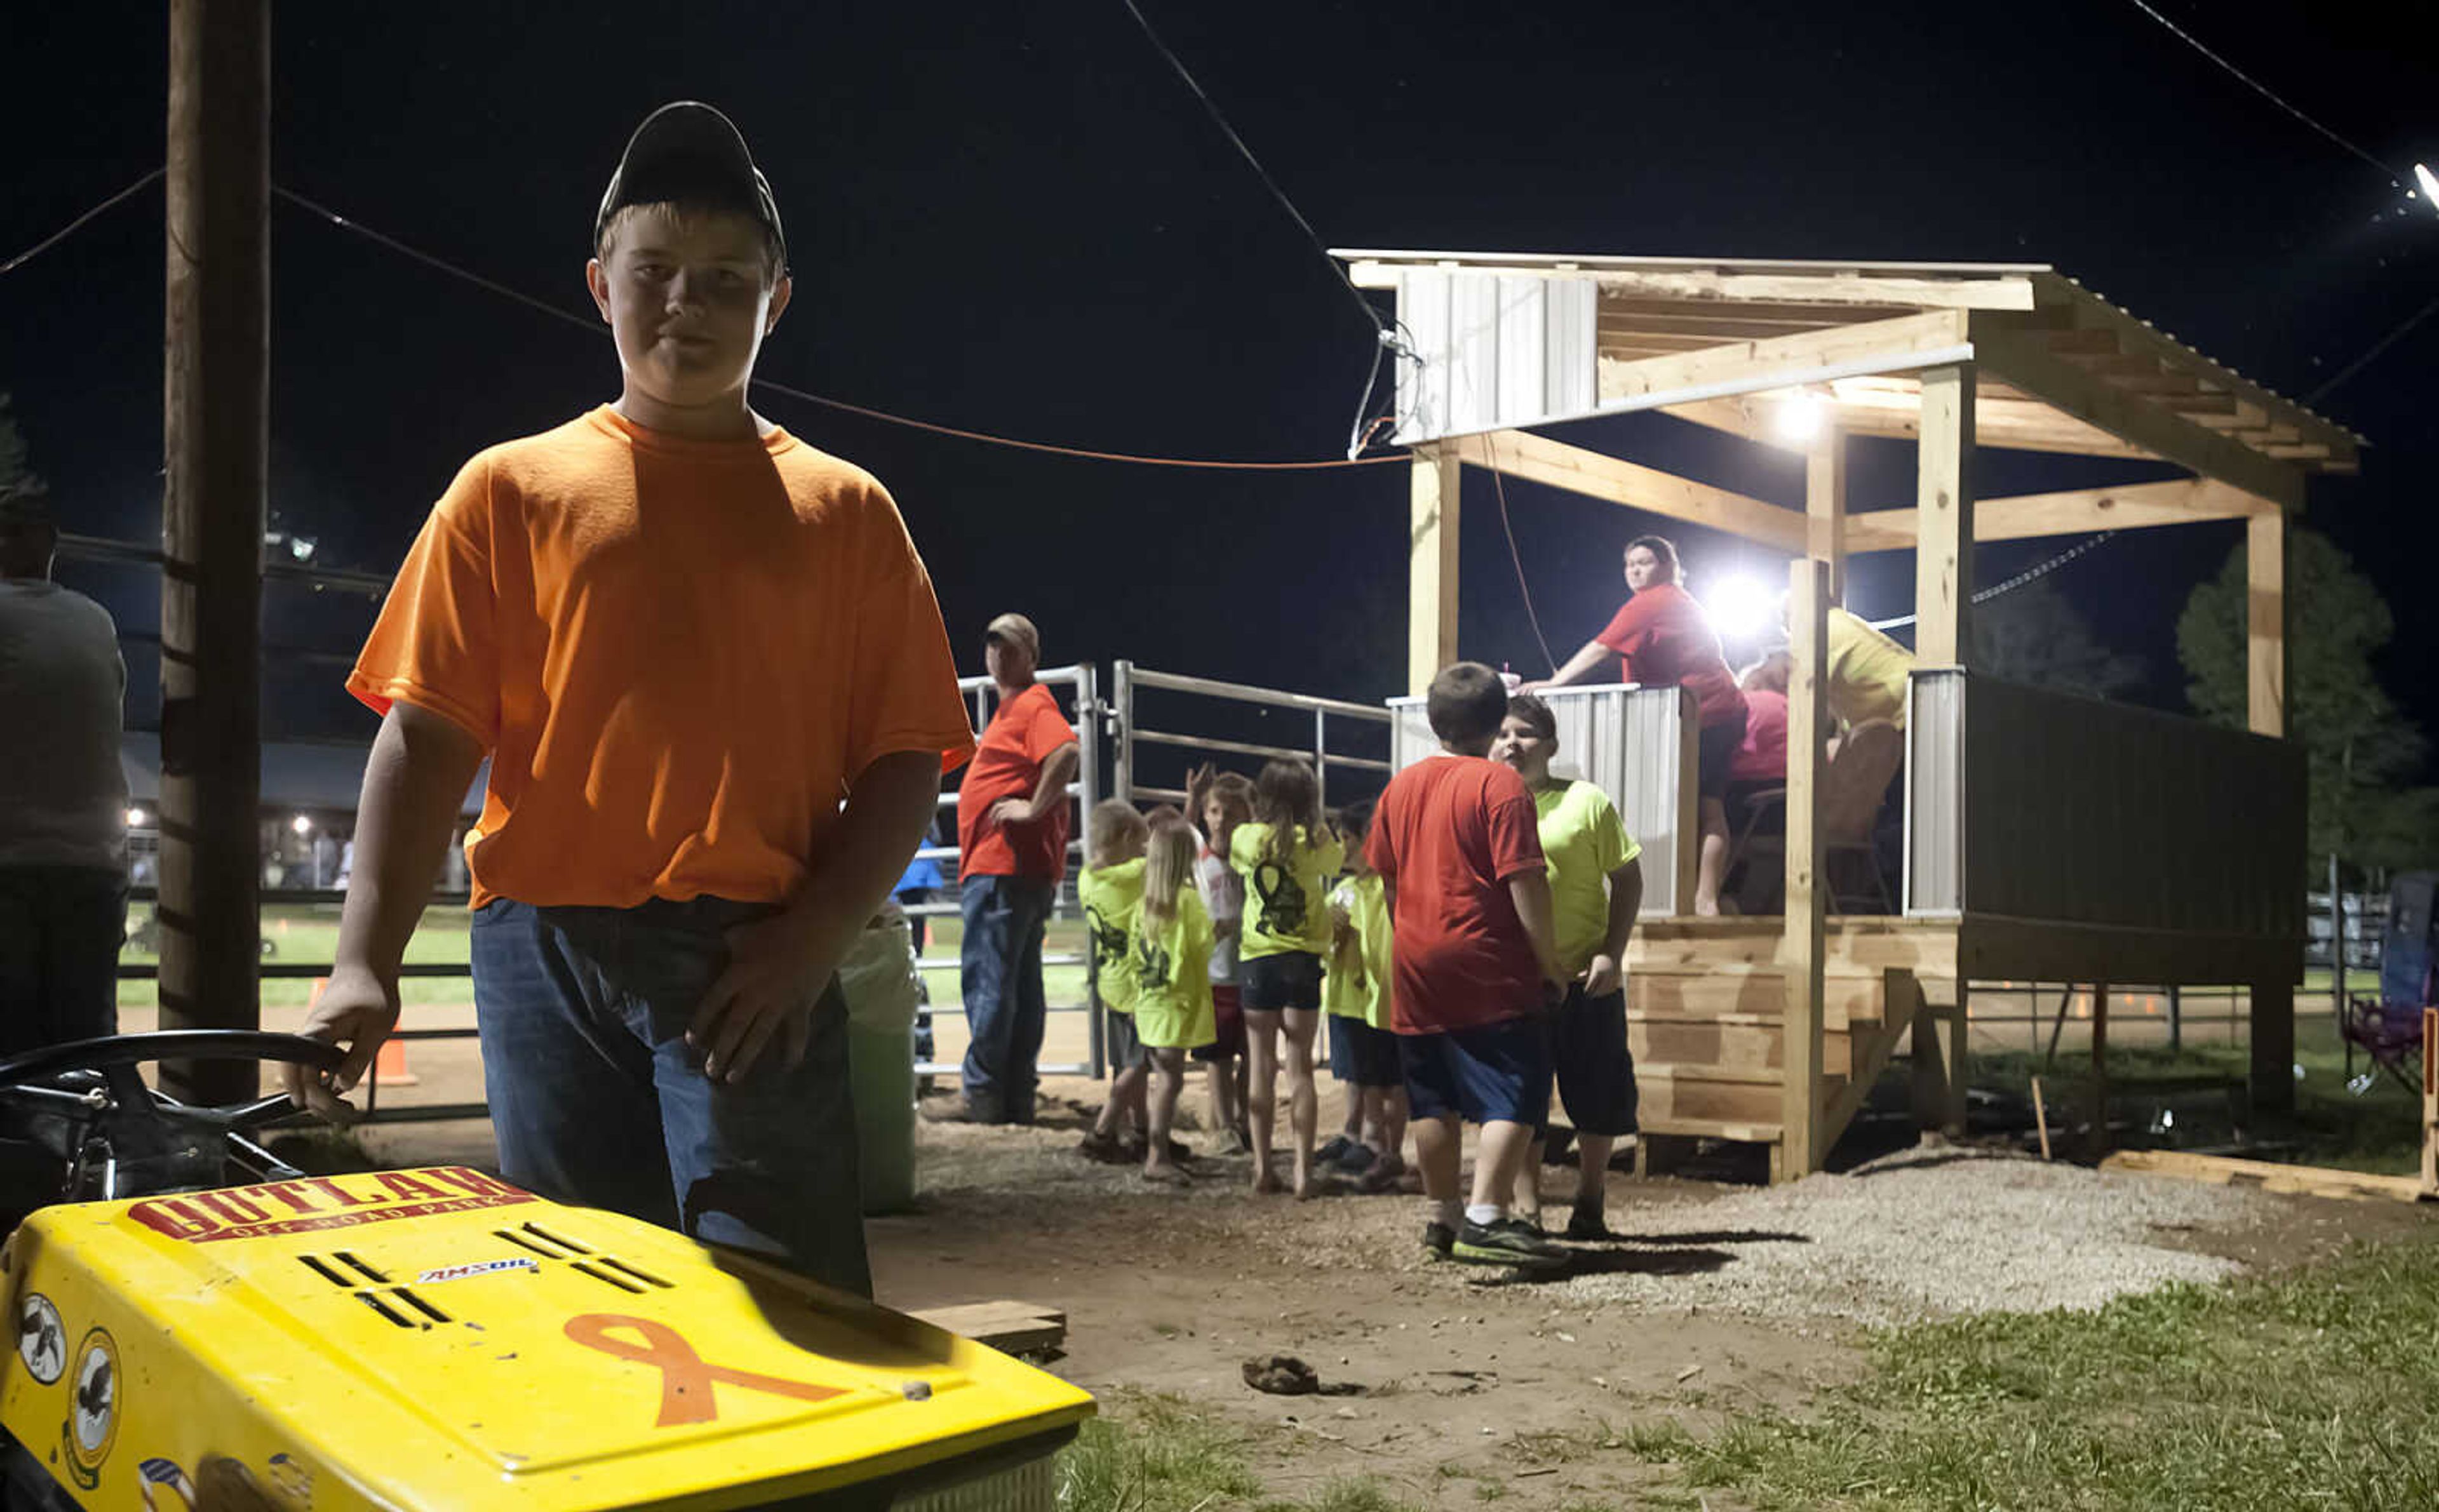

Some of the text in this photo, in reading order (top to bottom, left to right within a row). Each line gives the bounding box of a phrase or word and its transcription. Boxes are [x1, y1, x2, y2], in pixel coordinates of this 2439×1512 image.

[128, 1166, 534, 1239] OUTLAW
[419, 1196, 504, 1215] PARK
[424, 1259, 532, 1281] AMSOIL
